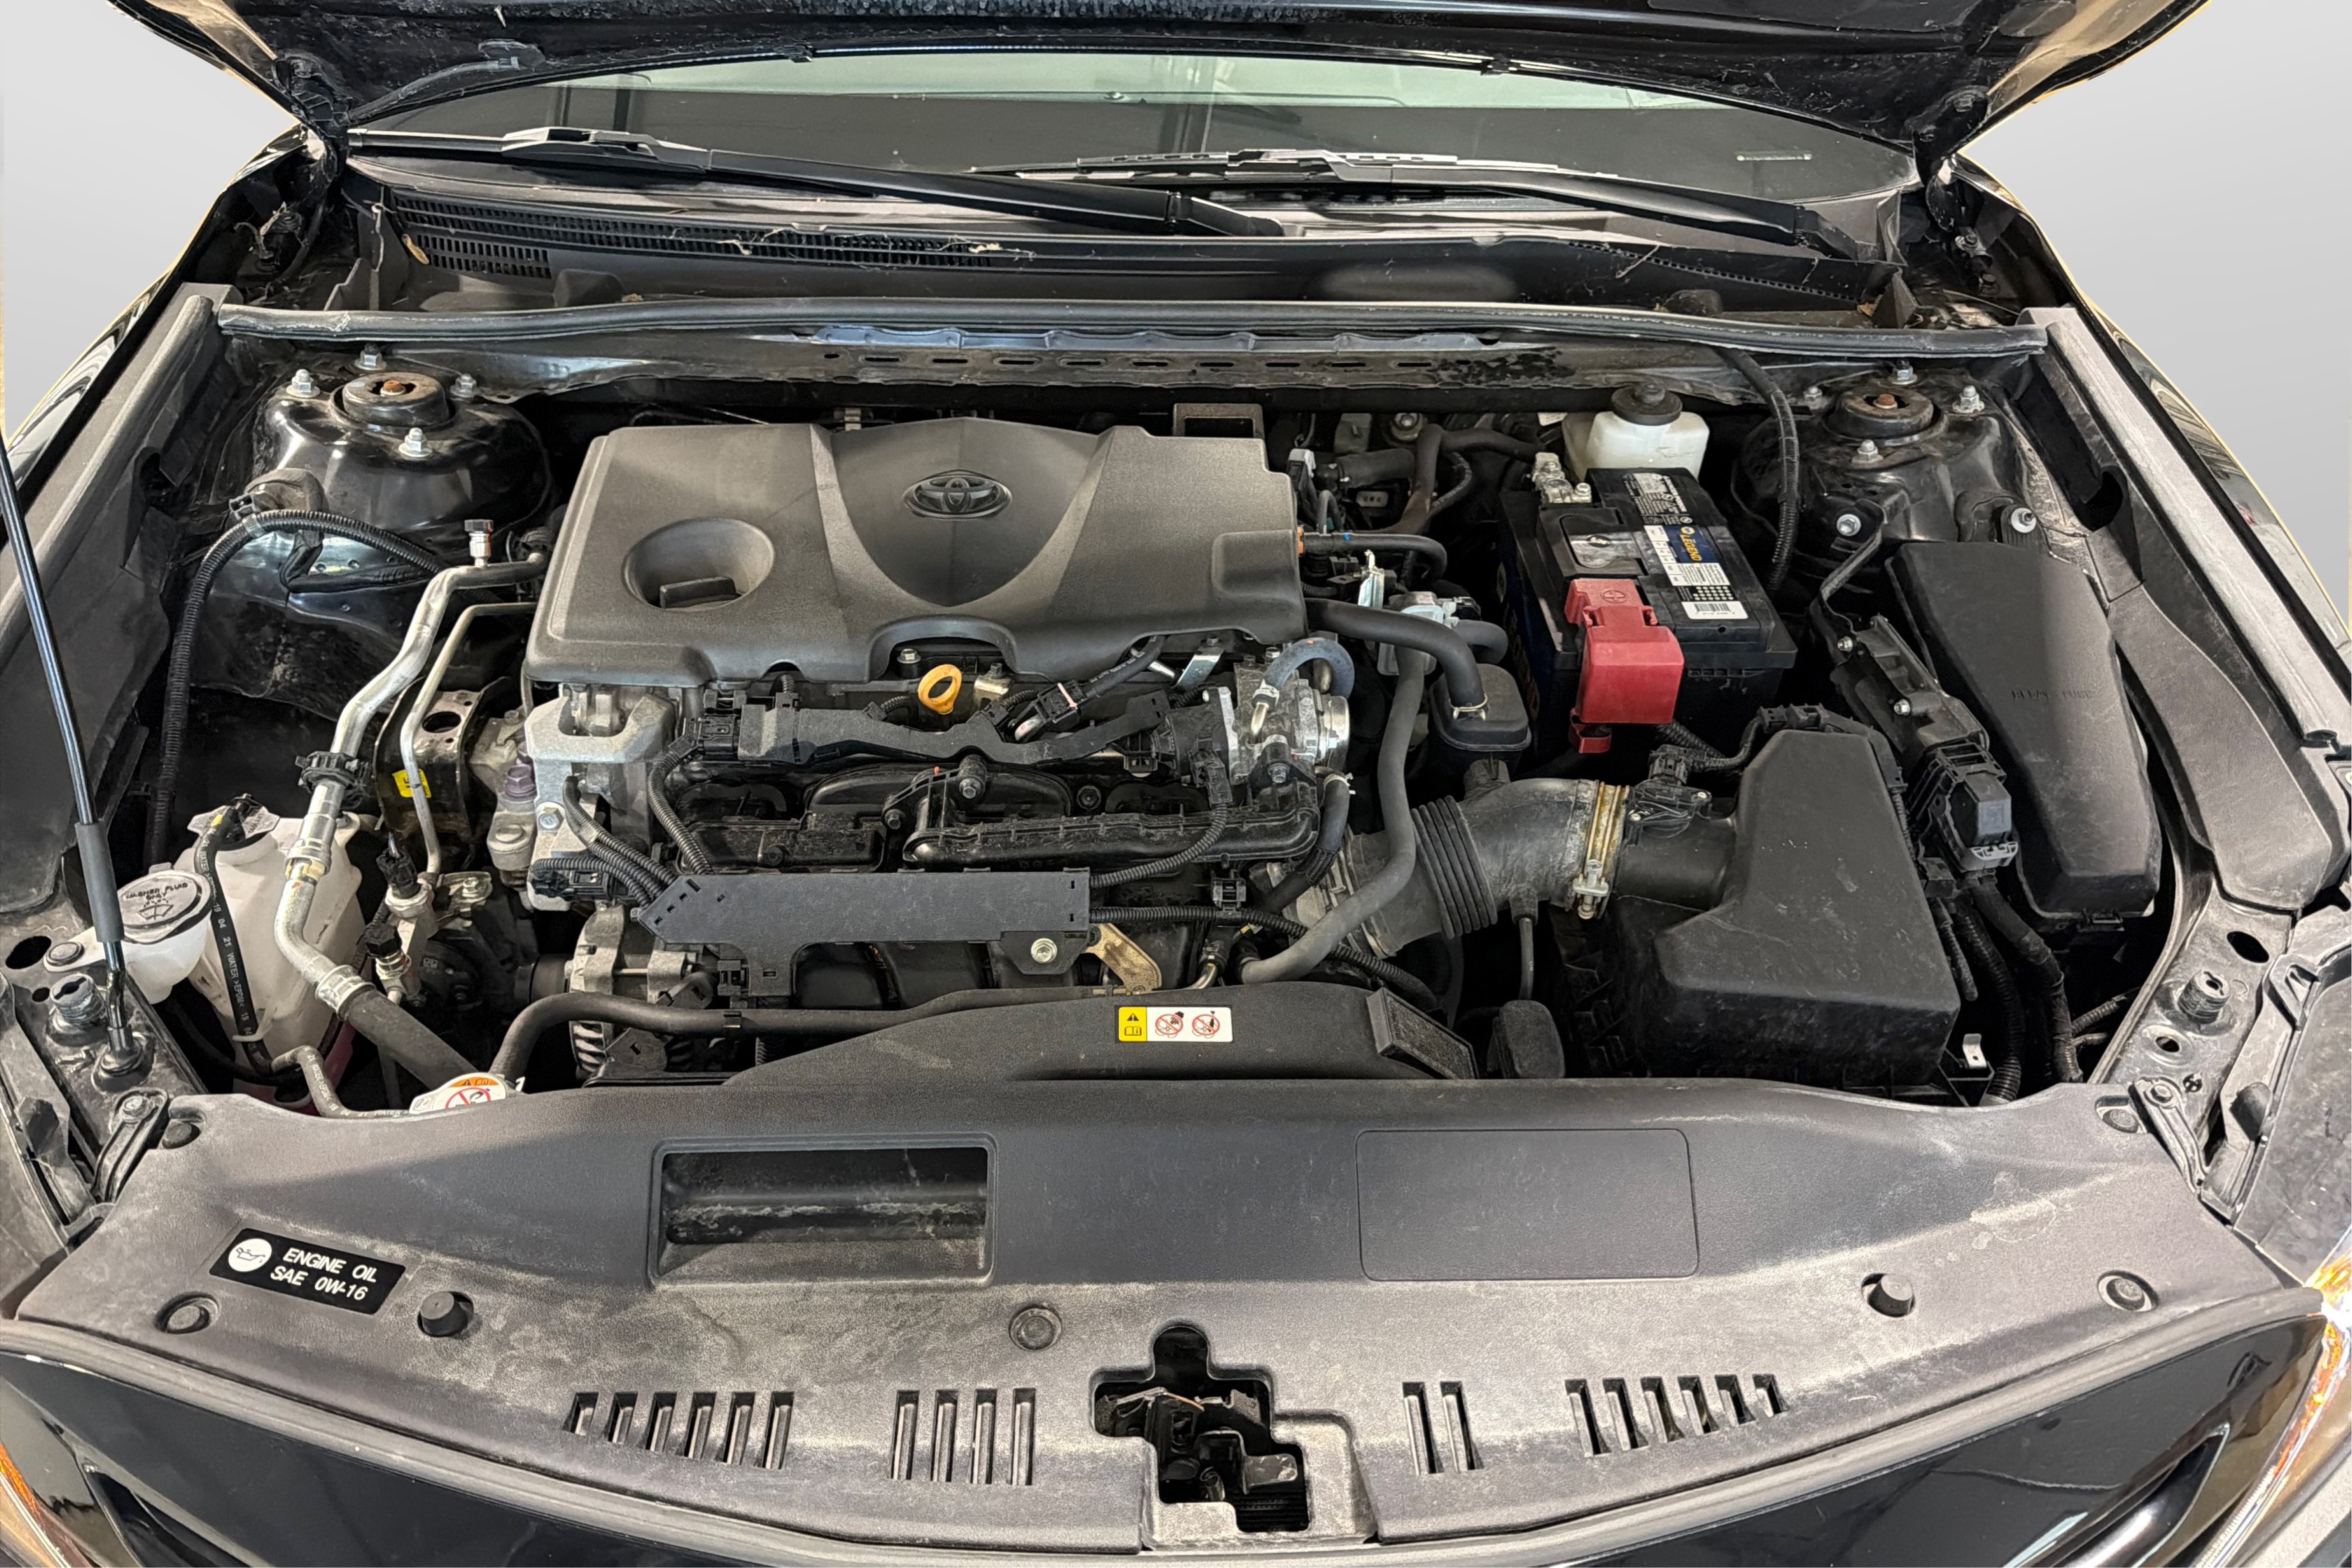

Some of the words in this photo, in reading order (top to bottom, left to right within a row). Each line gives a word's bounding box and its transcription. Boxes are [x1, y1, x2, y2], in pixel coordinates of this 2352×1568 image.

[1680, 534, 1703, 561] LEGEND
[200, 851, 210, 872] WATER
[165, 882, 189, 891] FLUID
[213, 903, 222, 913] 19
[217, 918, 227, 929] 04
[223, 936, 232, 947] 21
[227, 952, 239, 979] WATER
[241, 1012, 249, 1021] 19
[283, 1247, 347, 1274] ENGINE
[352, 1264, 377, 1283] OIL
[270, 1265, 309, 1286] SAE
[314, 1277, 369, 1301] 0W-16
